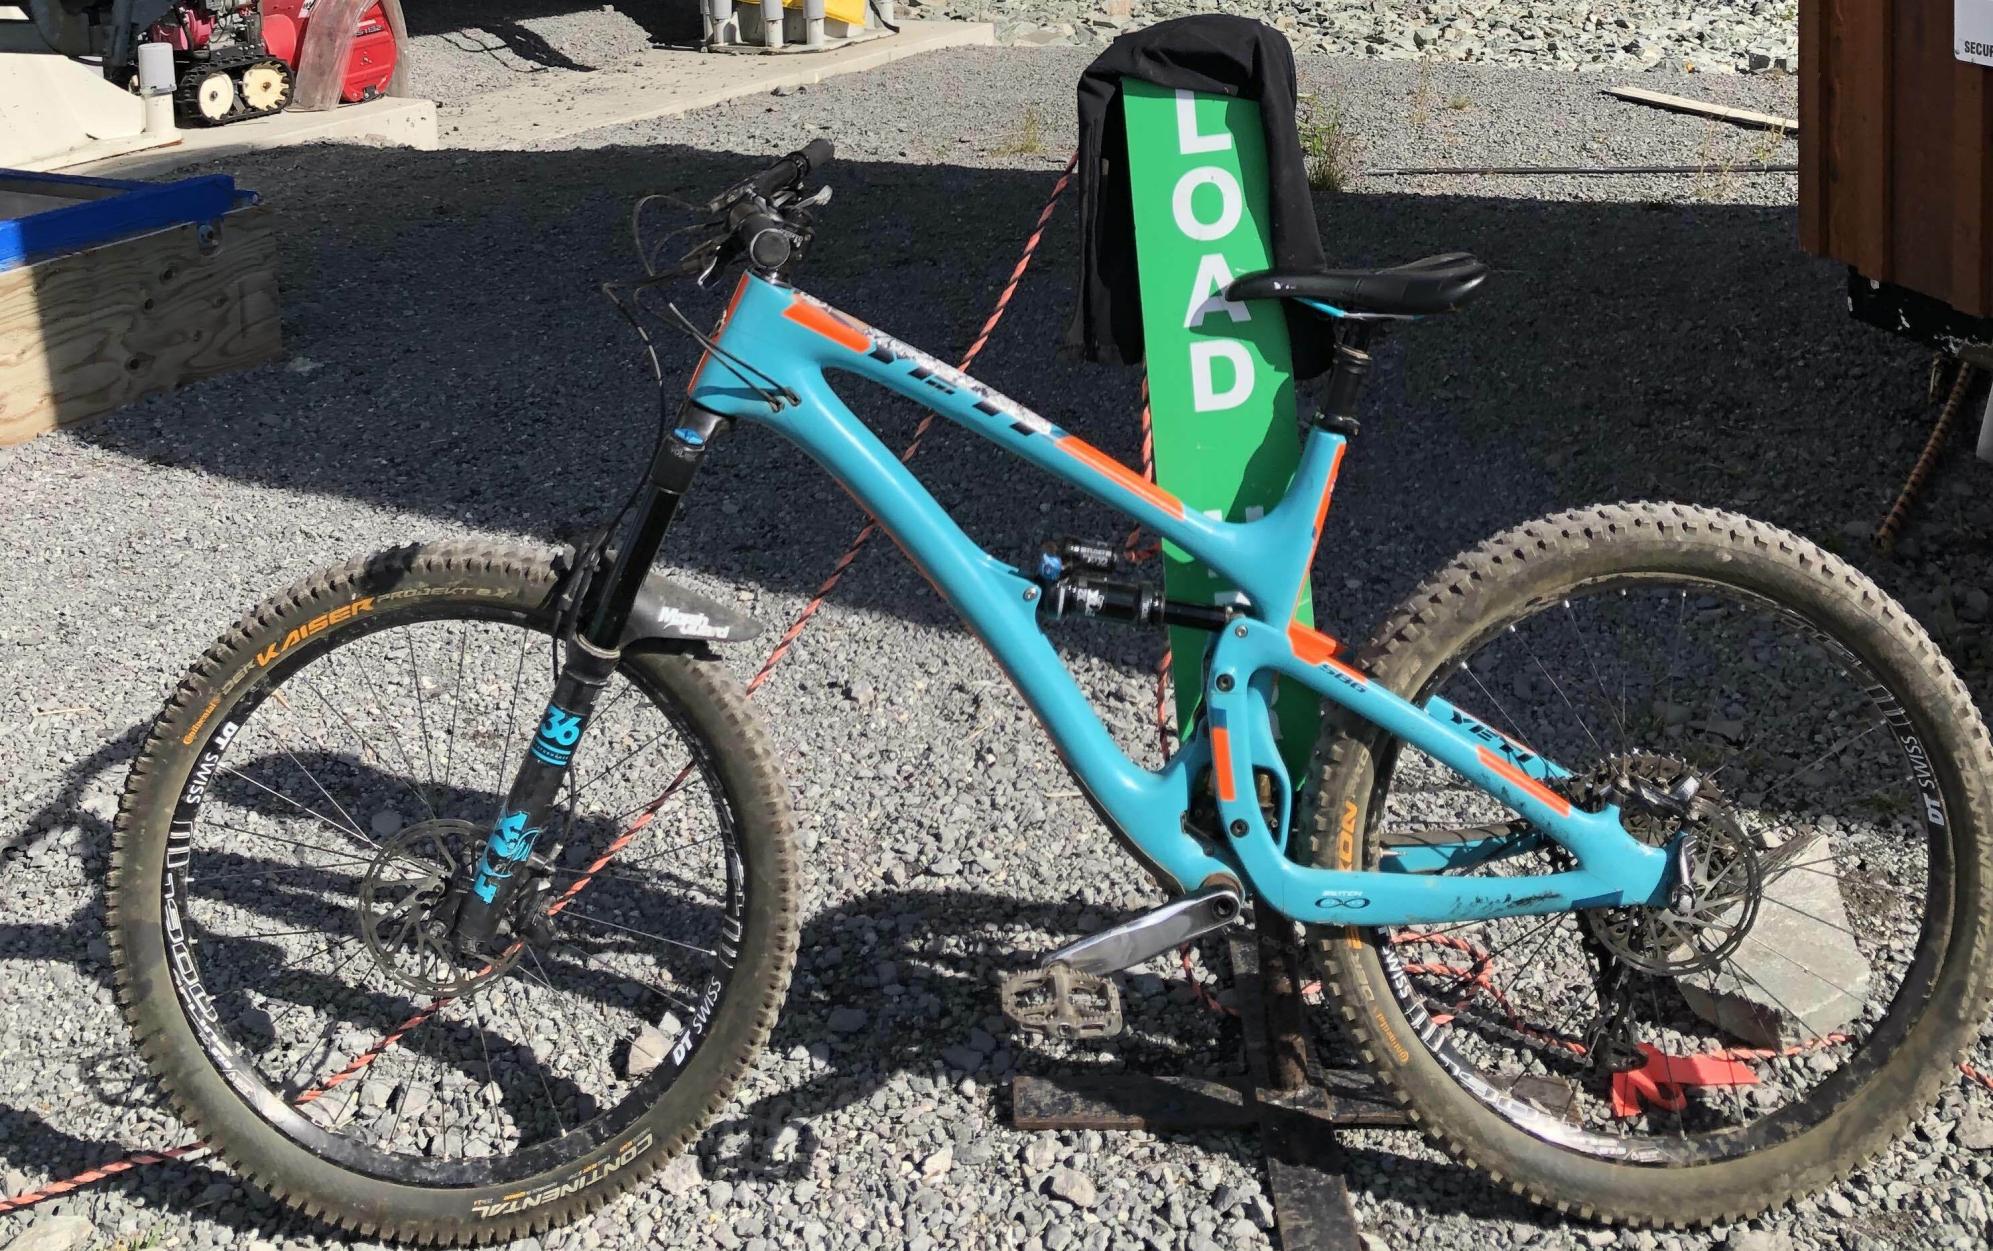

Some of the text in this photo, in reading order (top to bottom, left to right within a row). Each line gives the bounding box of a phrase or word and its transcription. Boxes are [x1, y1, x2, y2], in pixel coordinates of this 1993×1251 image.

[1172, 88, 1255, 413] LOAD
[257, 596, 376, 668] KAISER
[215, 721, 238, 751] DT
[541, 704, 582, 746] 36
[186, 752, 219, 804] SWISS
[1901, 735, 1935, 790] SWISS
[1923, 792, 1945, 826] DT
[672, 1029, 695, 1066] DT
[692, 976, 722, 1035] SWISS
[472, 1132, 653, 1220] CONTINENTAL
